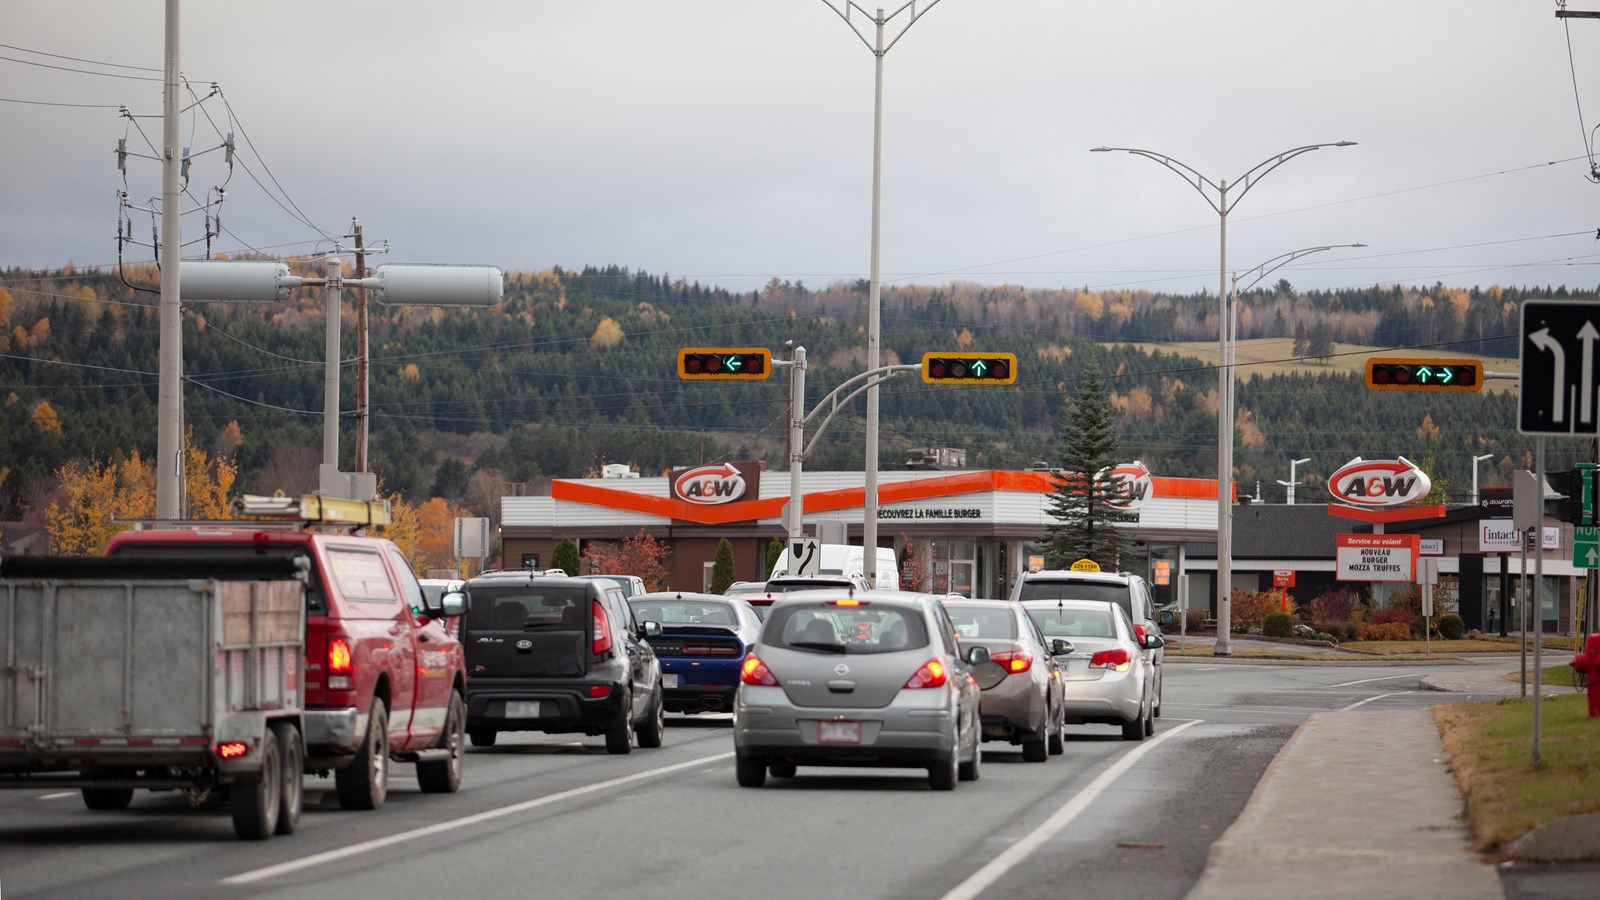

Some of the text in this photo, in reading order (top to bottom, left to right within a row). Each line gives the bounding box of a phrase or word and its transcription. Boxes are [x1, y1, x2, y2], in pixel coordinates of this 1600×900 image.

[686, 480, 738, 497] A&W
[1341, 476, 1416, 497] A&W
[915, 509, 924, 518] LA
[925, 509, 952, 518] FAMILLE
[954, 509, 981, 518] BURGER
[1488, 529, 1515, 540] intact
[1373, 564, 1401, 572] TRUFFES
